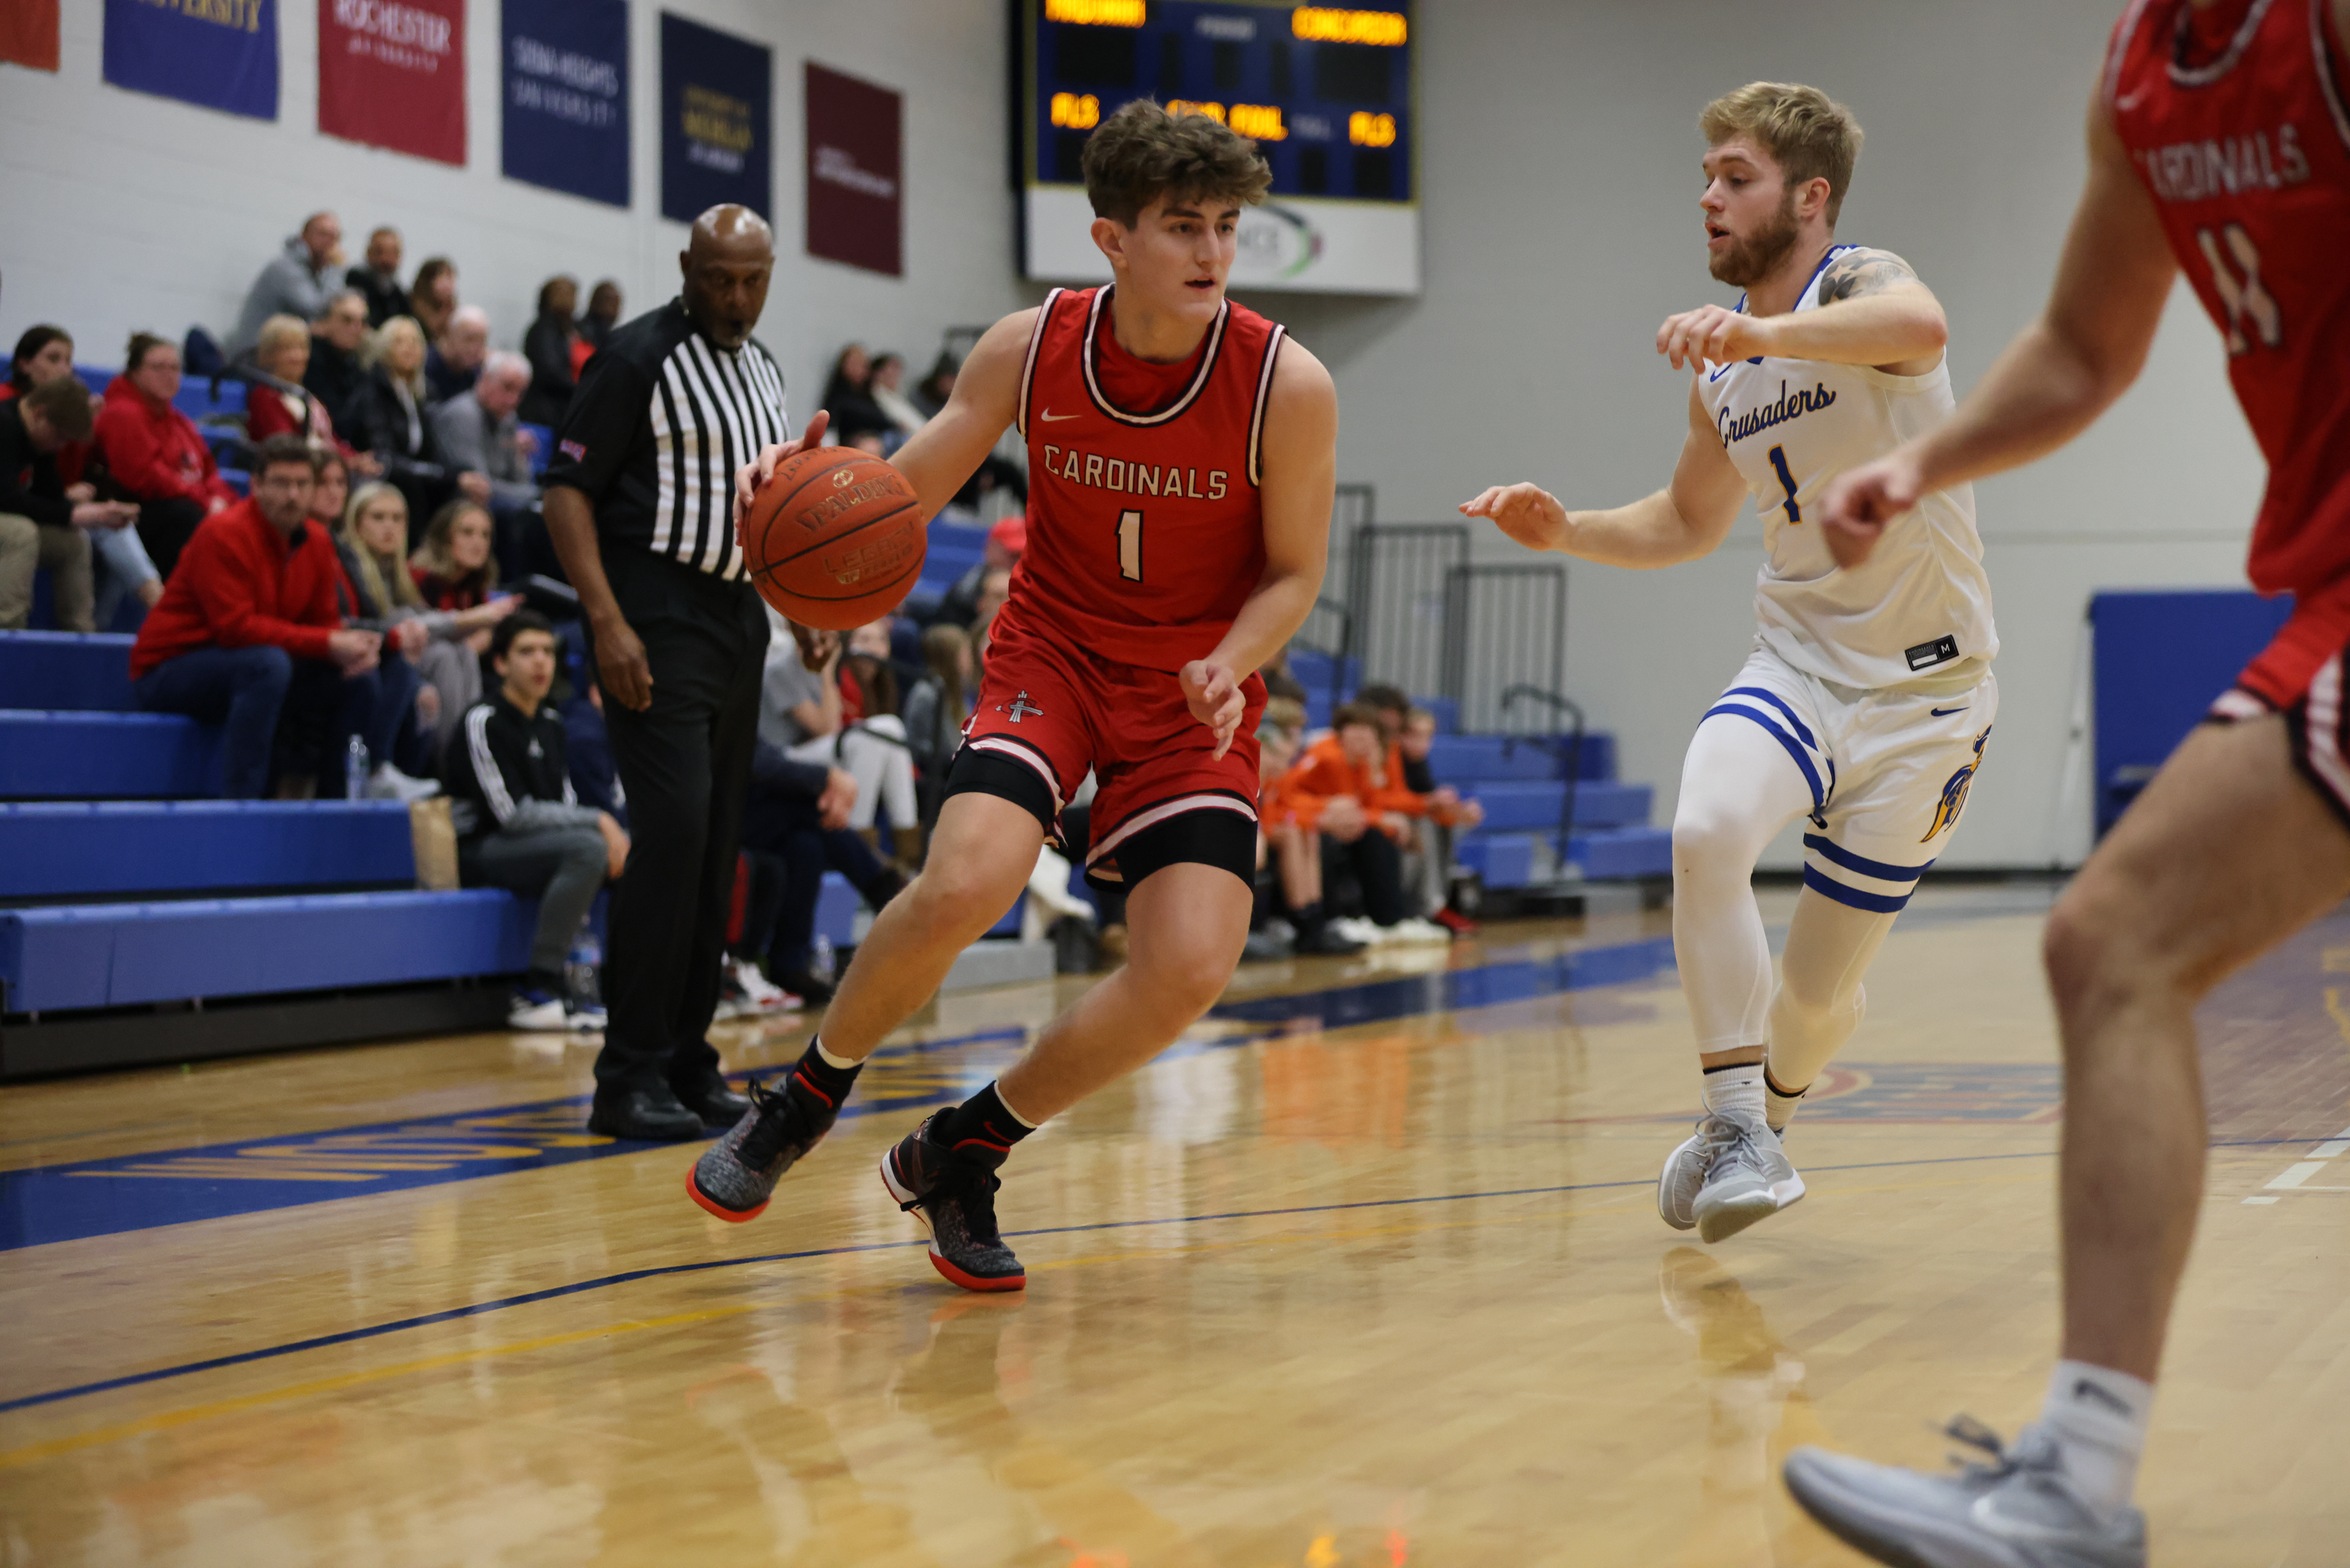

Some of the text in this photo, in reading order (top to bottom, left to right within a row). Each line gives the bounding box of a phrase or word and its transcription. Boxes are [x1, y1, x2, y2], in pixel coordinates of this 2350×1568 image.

[1718, 379, 1837, 449] Crusaders
[1043, 444, 1228, 500] CARDINALS
[1767, 443, 1803, 526] 1
[1114, 508, 1144, 583] 1
[1940, 643, 1951, 654] M
